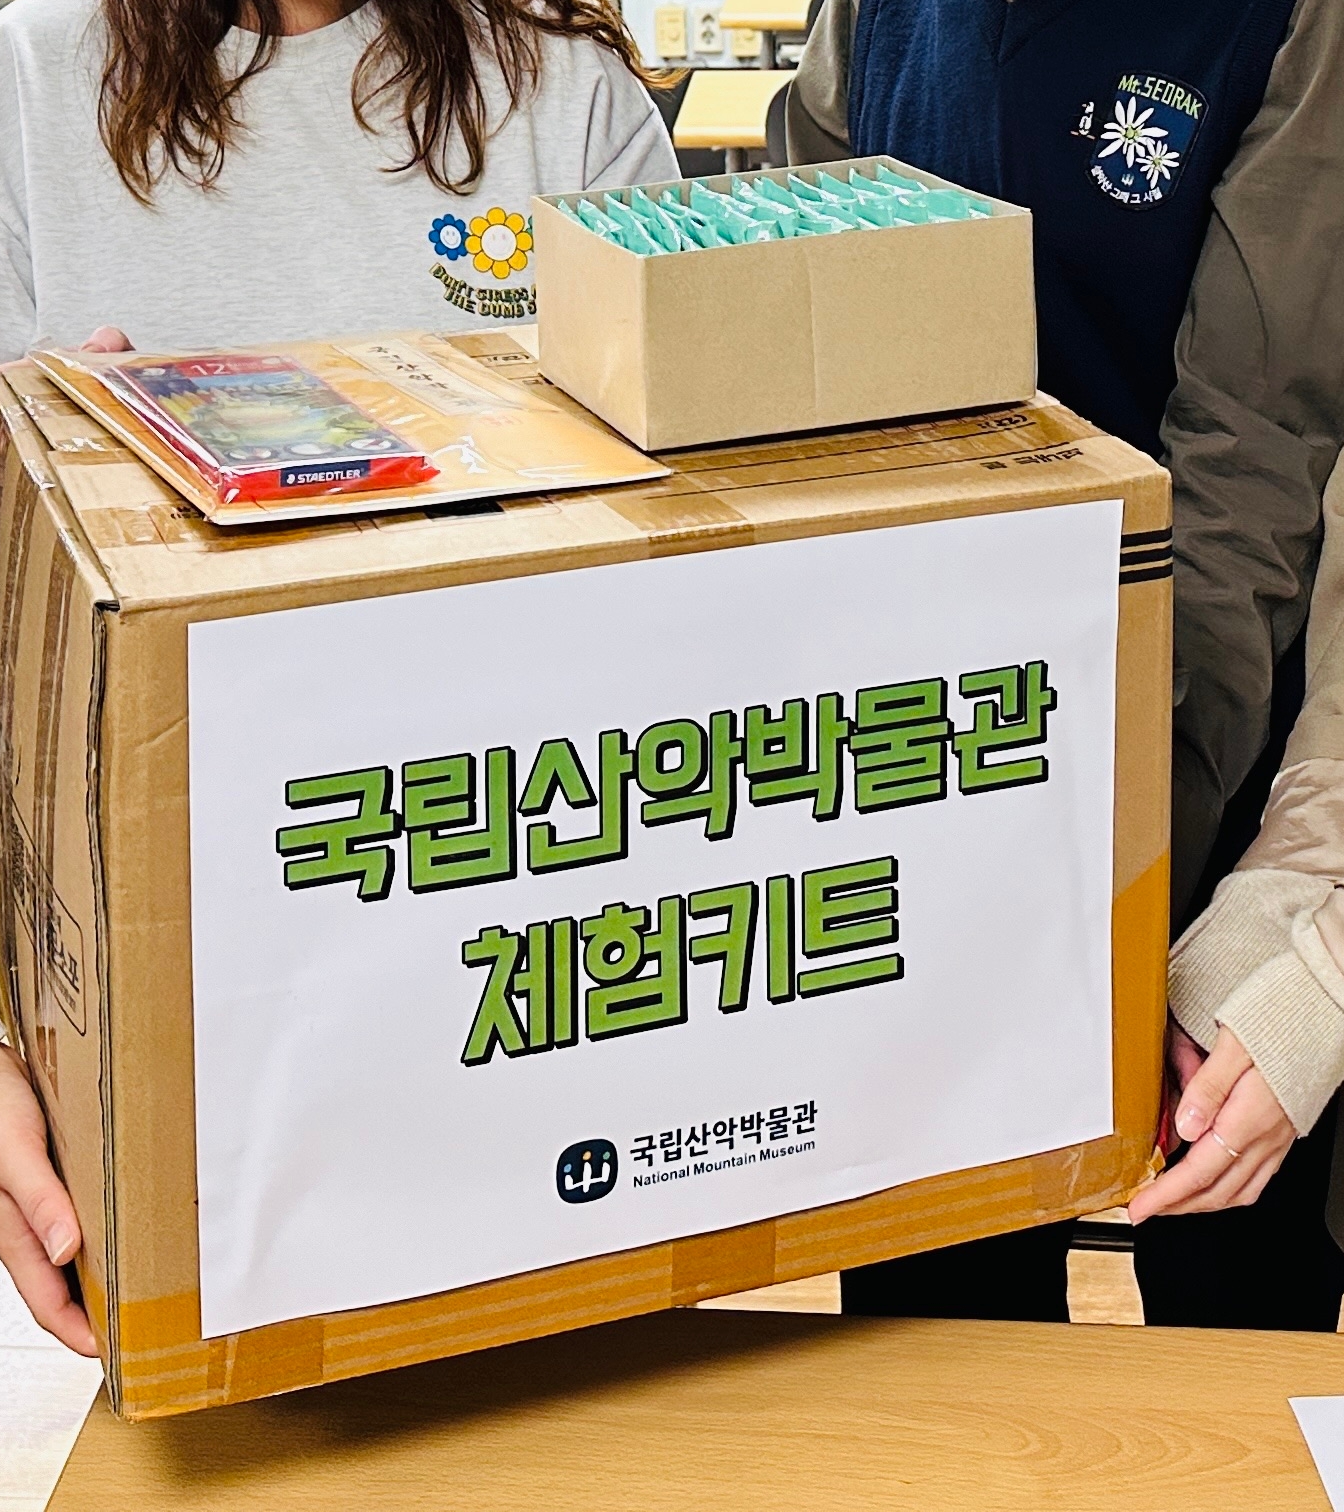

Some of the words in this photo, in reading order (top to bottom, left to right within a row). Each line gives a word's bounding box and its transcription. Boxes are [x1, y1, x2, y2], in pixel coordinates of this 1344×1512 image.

[1117, 74, 1203, 120] Mt.SEORAK
[443, 287, 477, 315] THE
[476, 287, 529, 302] STRESS
[191, 363, 232, 376] 12
[296, 468, 362, 484] STAEDTLER
[274, 660, 1058, 900] 국립산악박물관
[459, 854, 905, 1067] 체험키트
[629, 1100, 819, 1168] 국립산악박물관
[632, 1164, 691, 1189] National
[692, 1152, 757, 1176] Mountain
[759, 1139, 816, 1162] Museum
